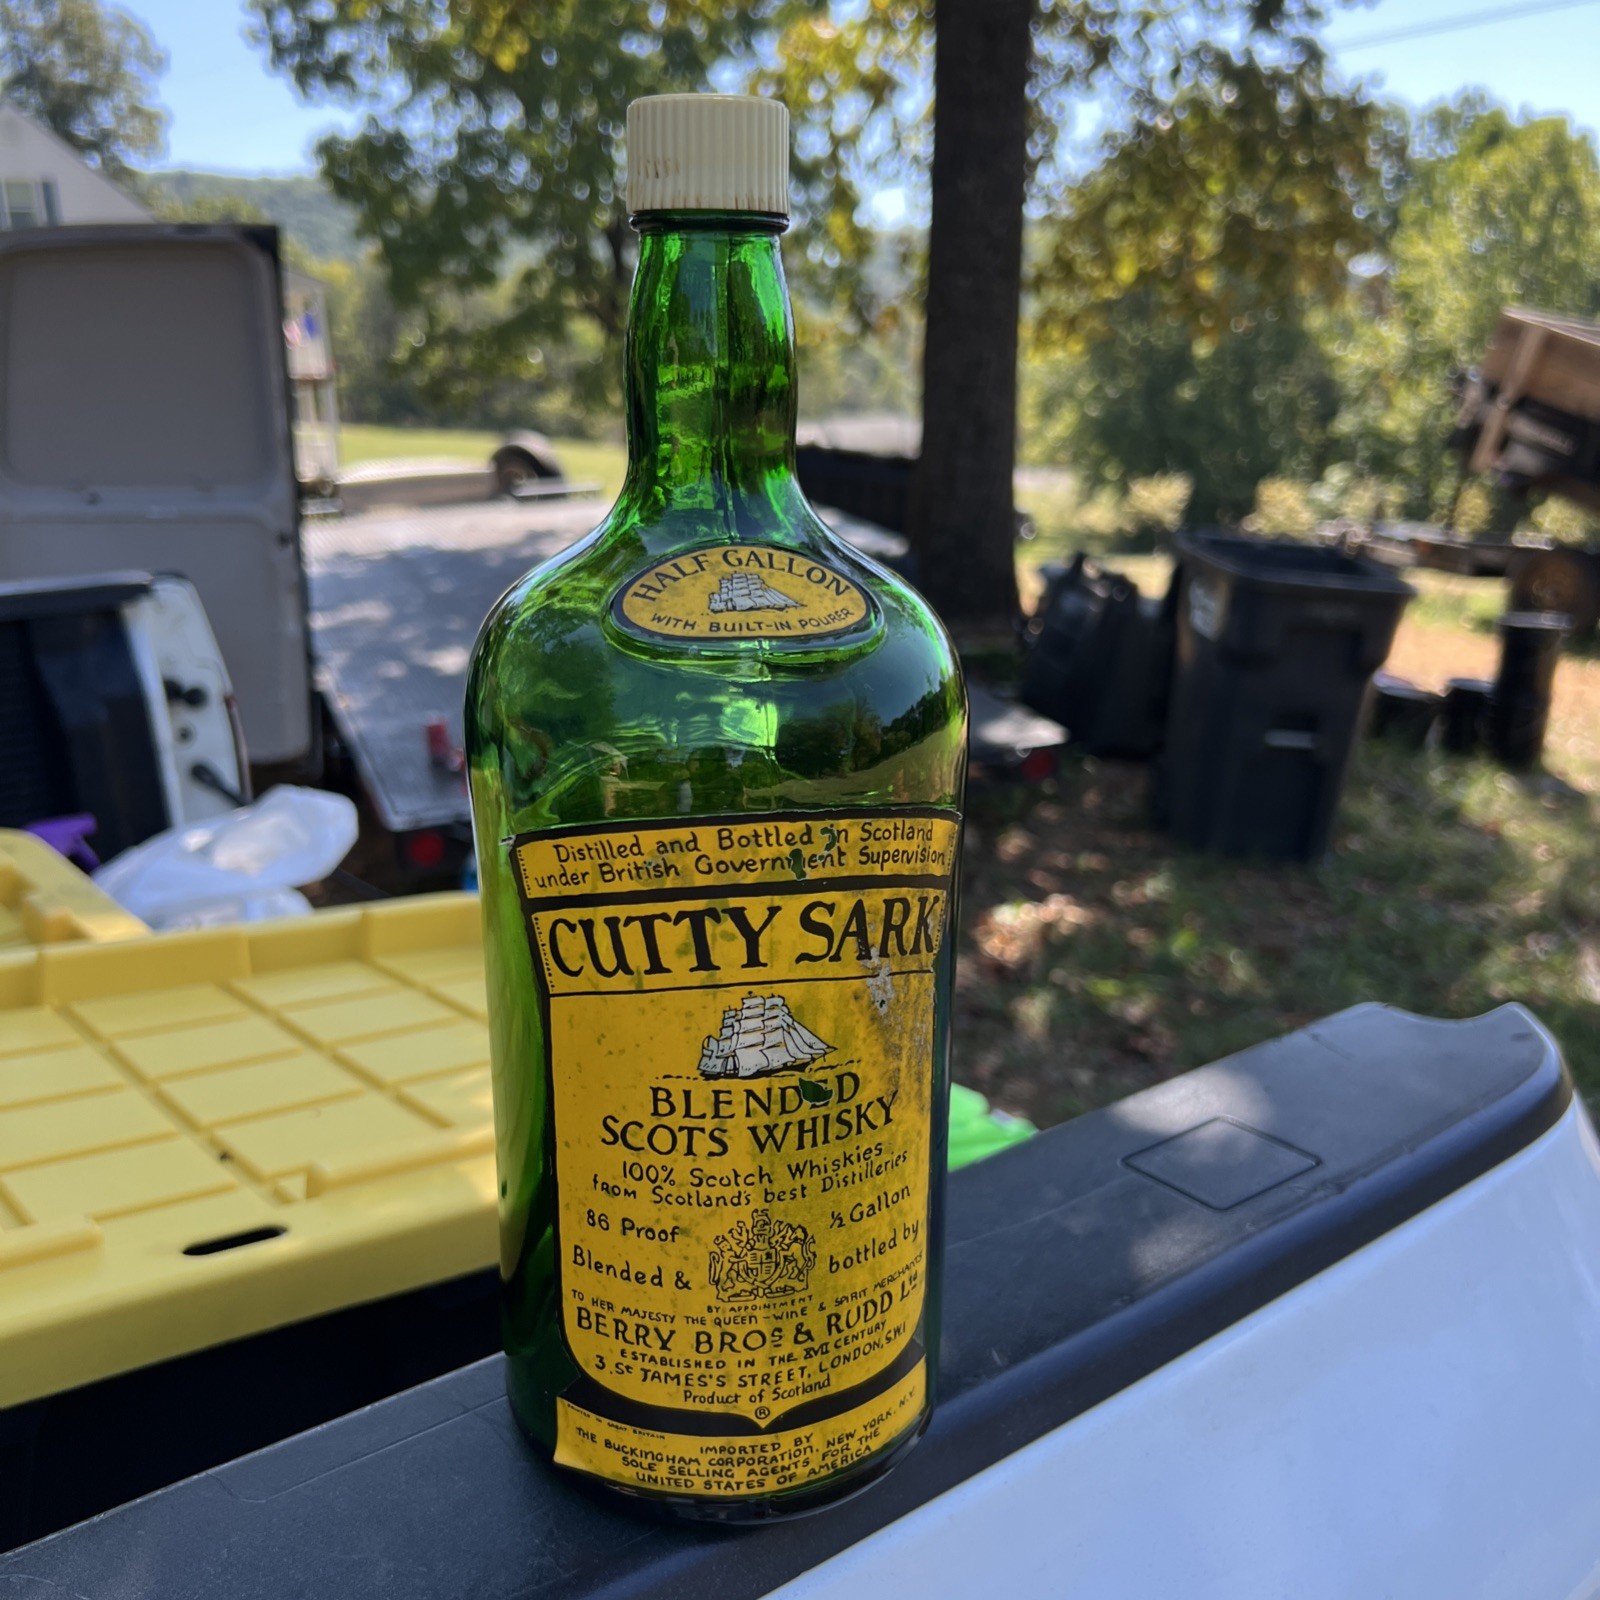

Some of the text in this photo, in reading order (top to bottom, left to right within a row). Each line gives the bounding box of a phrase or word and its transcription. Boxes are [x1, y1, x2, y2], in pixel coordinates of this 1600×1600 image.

[631, 549, 850, 602] HALF GALLON
[651, 608, 854, 633] WITH BUILT-IN POURER
[553, 834, 644, 863] Distilled
[656, 831, 702, 854] and
[717, 823, 814, 850] Bottled
[860, 820, 933, 842] Scotland
[534, 864, 590, 889] under
[599, 857, 680, 883] British
[858, 845, 945, 871] Supervision
[548, 905, 782, 977] CUTTY
[795, 894, 940, 964] SARK
[601, 1089, 899, 1157] SCOTS WHISKY
[623, 1142, 883, 1188] 100% Scotch Whiskies
[652, 1185, 751, 1207] Scotland's
[764, 1184, 807, 1203] best
[821, 1150, 908, 1193] Distilleries
[587, 1208, 680, 1243] 86 Proof
[850, 1185, 911, 1223] Gallon
[572, 1244, 692, 1291] Blended &
[829, 1219, 919, 1274] bottled by
[571, 1288, 584, 1301] TO
[591, 1297, 615, 1312] HER
[621, 1306, 676, 1324] MAJESTY
[684, 1315, 706, 1326] THE
[818, 1301, 826, 1312] &
[834, 1287, 868, 1307] SPIRIT
[576, 1306, 676, 1351] BERRY
[793, 1321, 814, 1345] &
[826, 1290, 893, 1336] RUDD
[706, 1294, 813, 1313] BY APPOINTMENT
[620, 1348, 726, 1369] ESTABLISHED
[737, 1358, 755, 1368] IN
[768, 1352, 798, 1366] THE
[834, 1319, 886, 1349] CENTURY
[640, 1368, 726, 1387] JAMES'S
[683, 1373, 831, 1404] Product of Scotland
[576, 1427, 597, 1443] THE
[604, 1439, 701, 1466] BUCKINGHAM
[826, 1428, 857, 1449] NEW
[622, 1427, 880, 1478] SOLE SELLING AGENTS FOR THE
[699, 1433, 814, 1455] IMPORTED BY
[636, 1445, 872, 1491] UNITED STATES OF AMERICA
